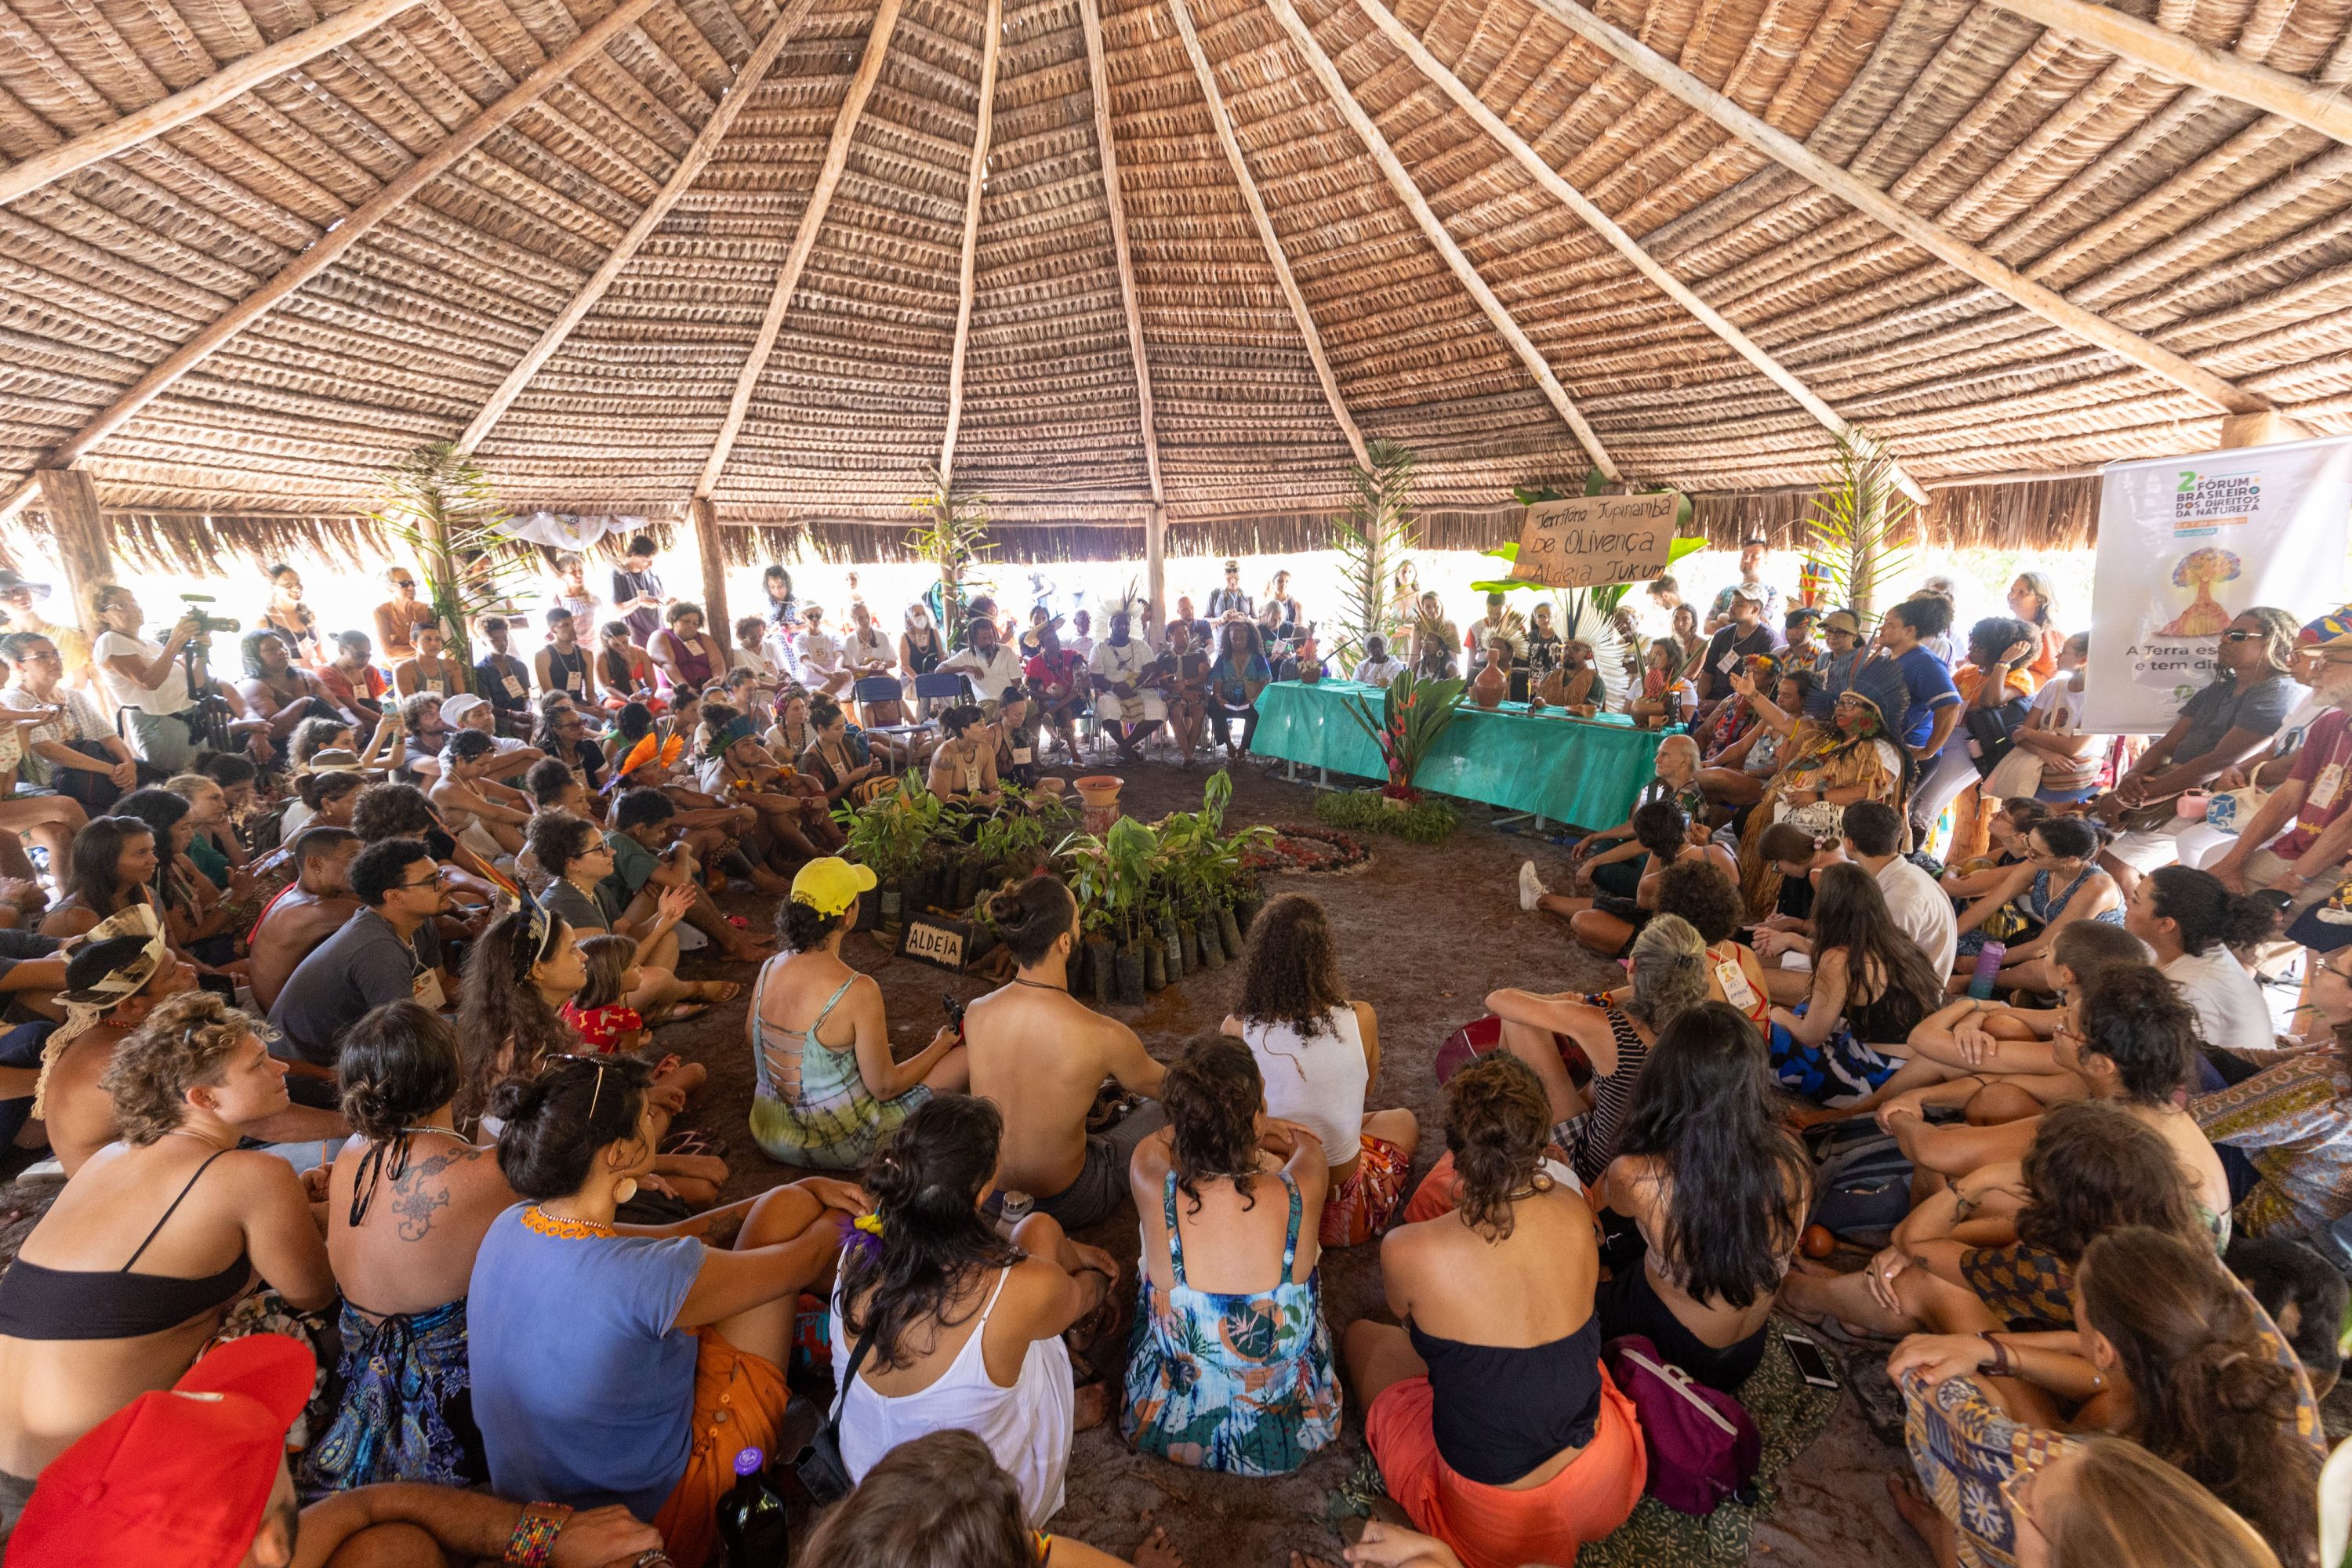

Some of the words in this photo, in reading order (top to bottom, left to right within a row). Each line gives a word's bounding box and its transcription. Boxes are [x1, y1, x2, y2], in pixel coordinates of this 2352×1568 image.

[2198, 477, 2250, 491] FÓRUM
[2176, 486, 2260, 502] BRASILEIRO
[2176, 501, 2200, 510] DOS
[2205, 495, 2260, 507] DIREITOS
[2196, 504, 2260, 516] NATUREZA
[2125, 646, 2139, 655] A
[2144, 645, 2189, 655] Terra
[2151, 661, 2187, 670] tem
